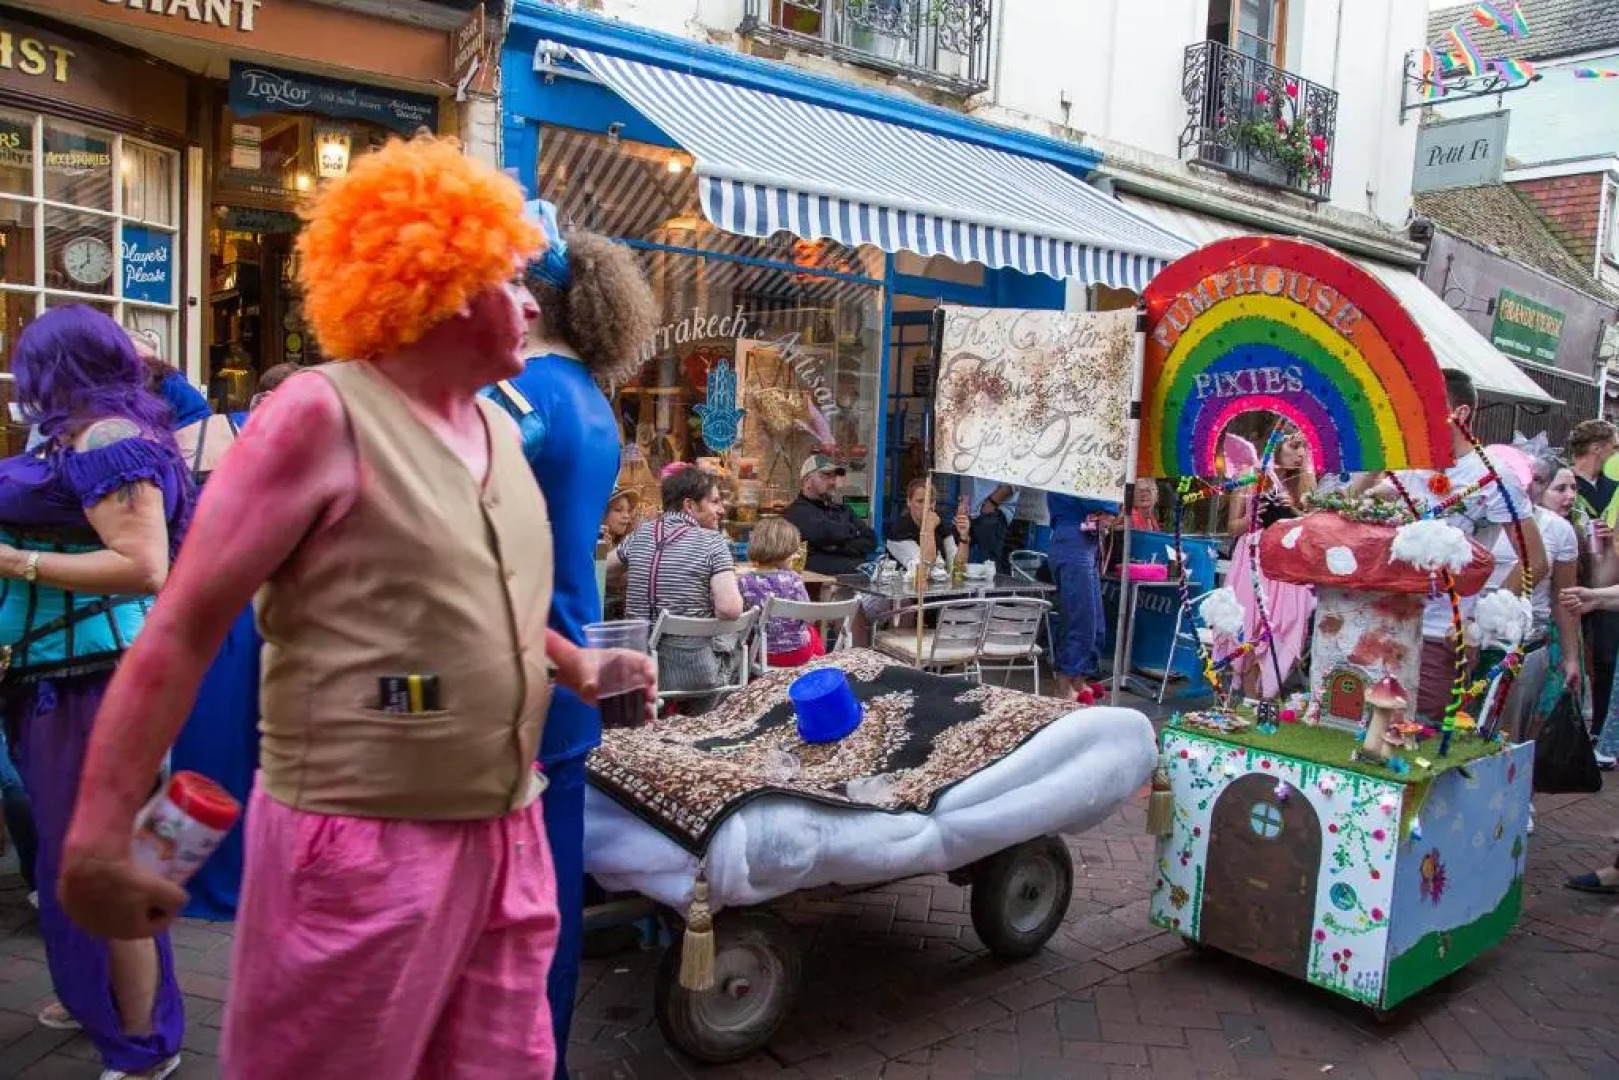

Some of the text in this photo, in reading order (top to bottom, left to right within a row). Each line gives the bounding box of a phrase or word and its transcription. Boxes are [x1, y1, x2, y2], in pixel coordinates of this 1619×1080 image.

[242, 70, 312, 107] Taylor
[1426, 145, 1465, 167] Petit
[126, 264, 167, 289] Please
[1152, 264, 1363, 351] PUMPHOUSE
[755, 329, 841, 417] Artisan
[1192, 365, 1305, 400] PIXIES
